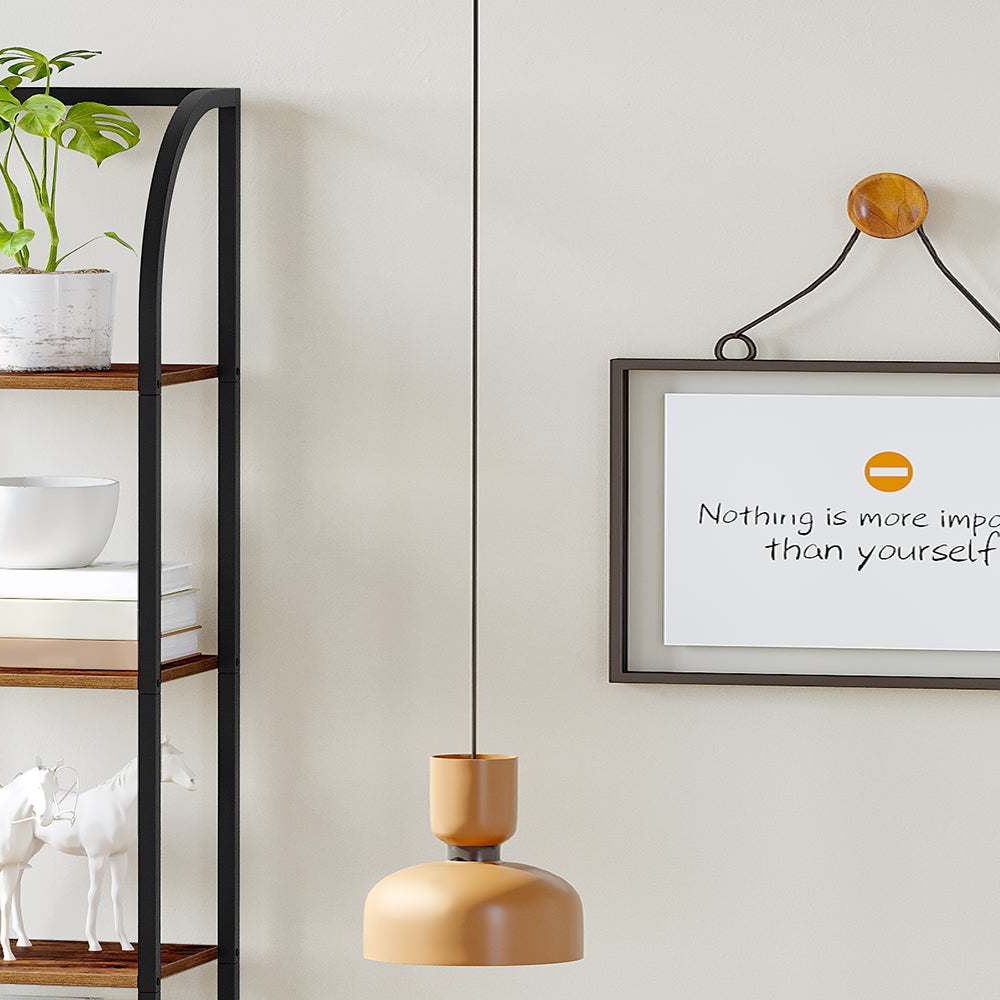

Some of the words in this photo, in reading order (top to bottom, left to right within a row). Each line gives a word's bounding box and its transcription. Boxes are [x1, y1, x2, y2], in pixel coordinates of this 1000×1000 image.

[698, 502, 814, 536] Nothing
[826, 507, 848, 526] is
[859, 510, 930, 528] more
[764, 537, 843, 561] than
[857, 530, 1000, 572] yourself
